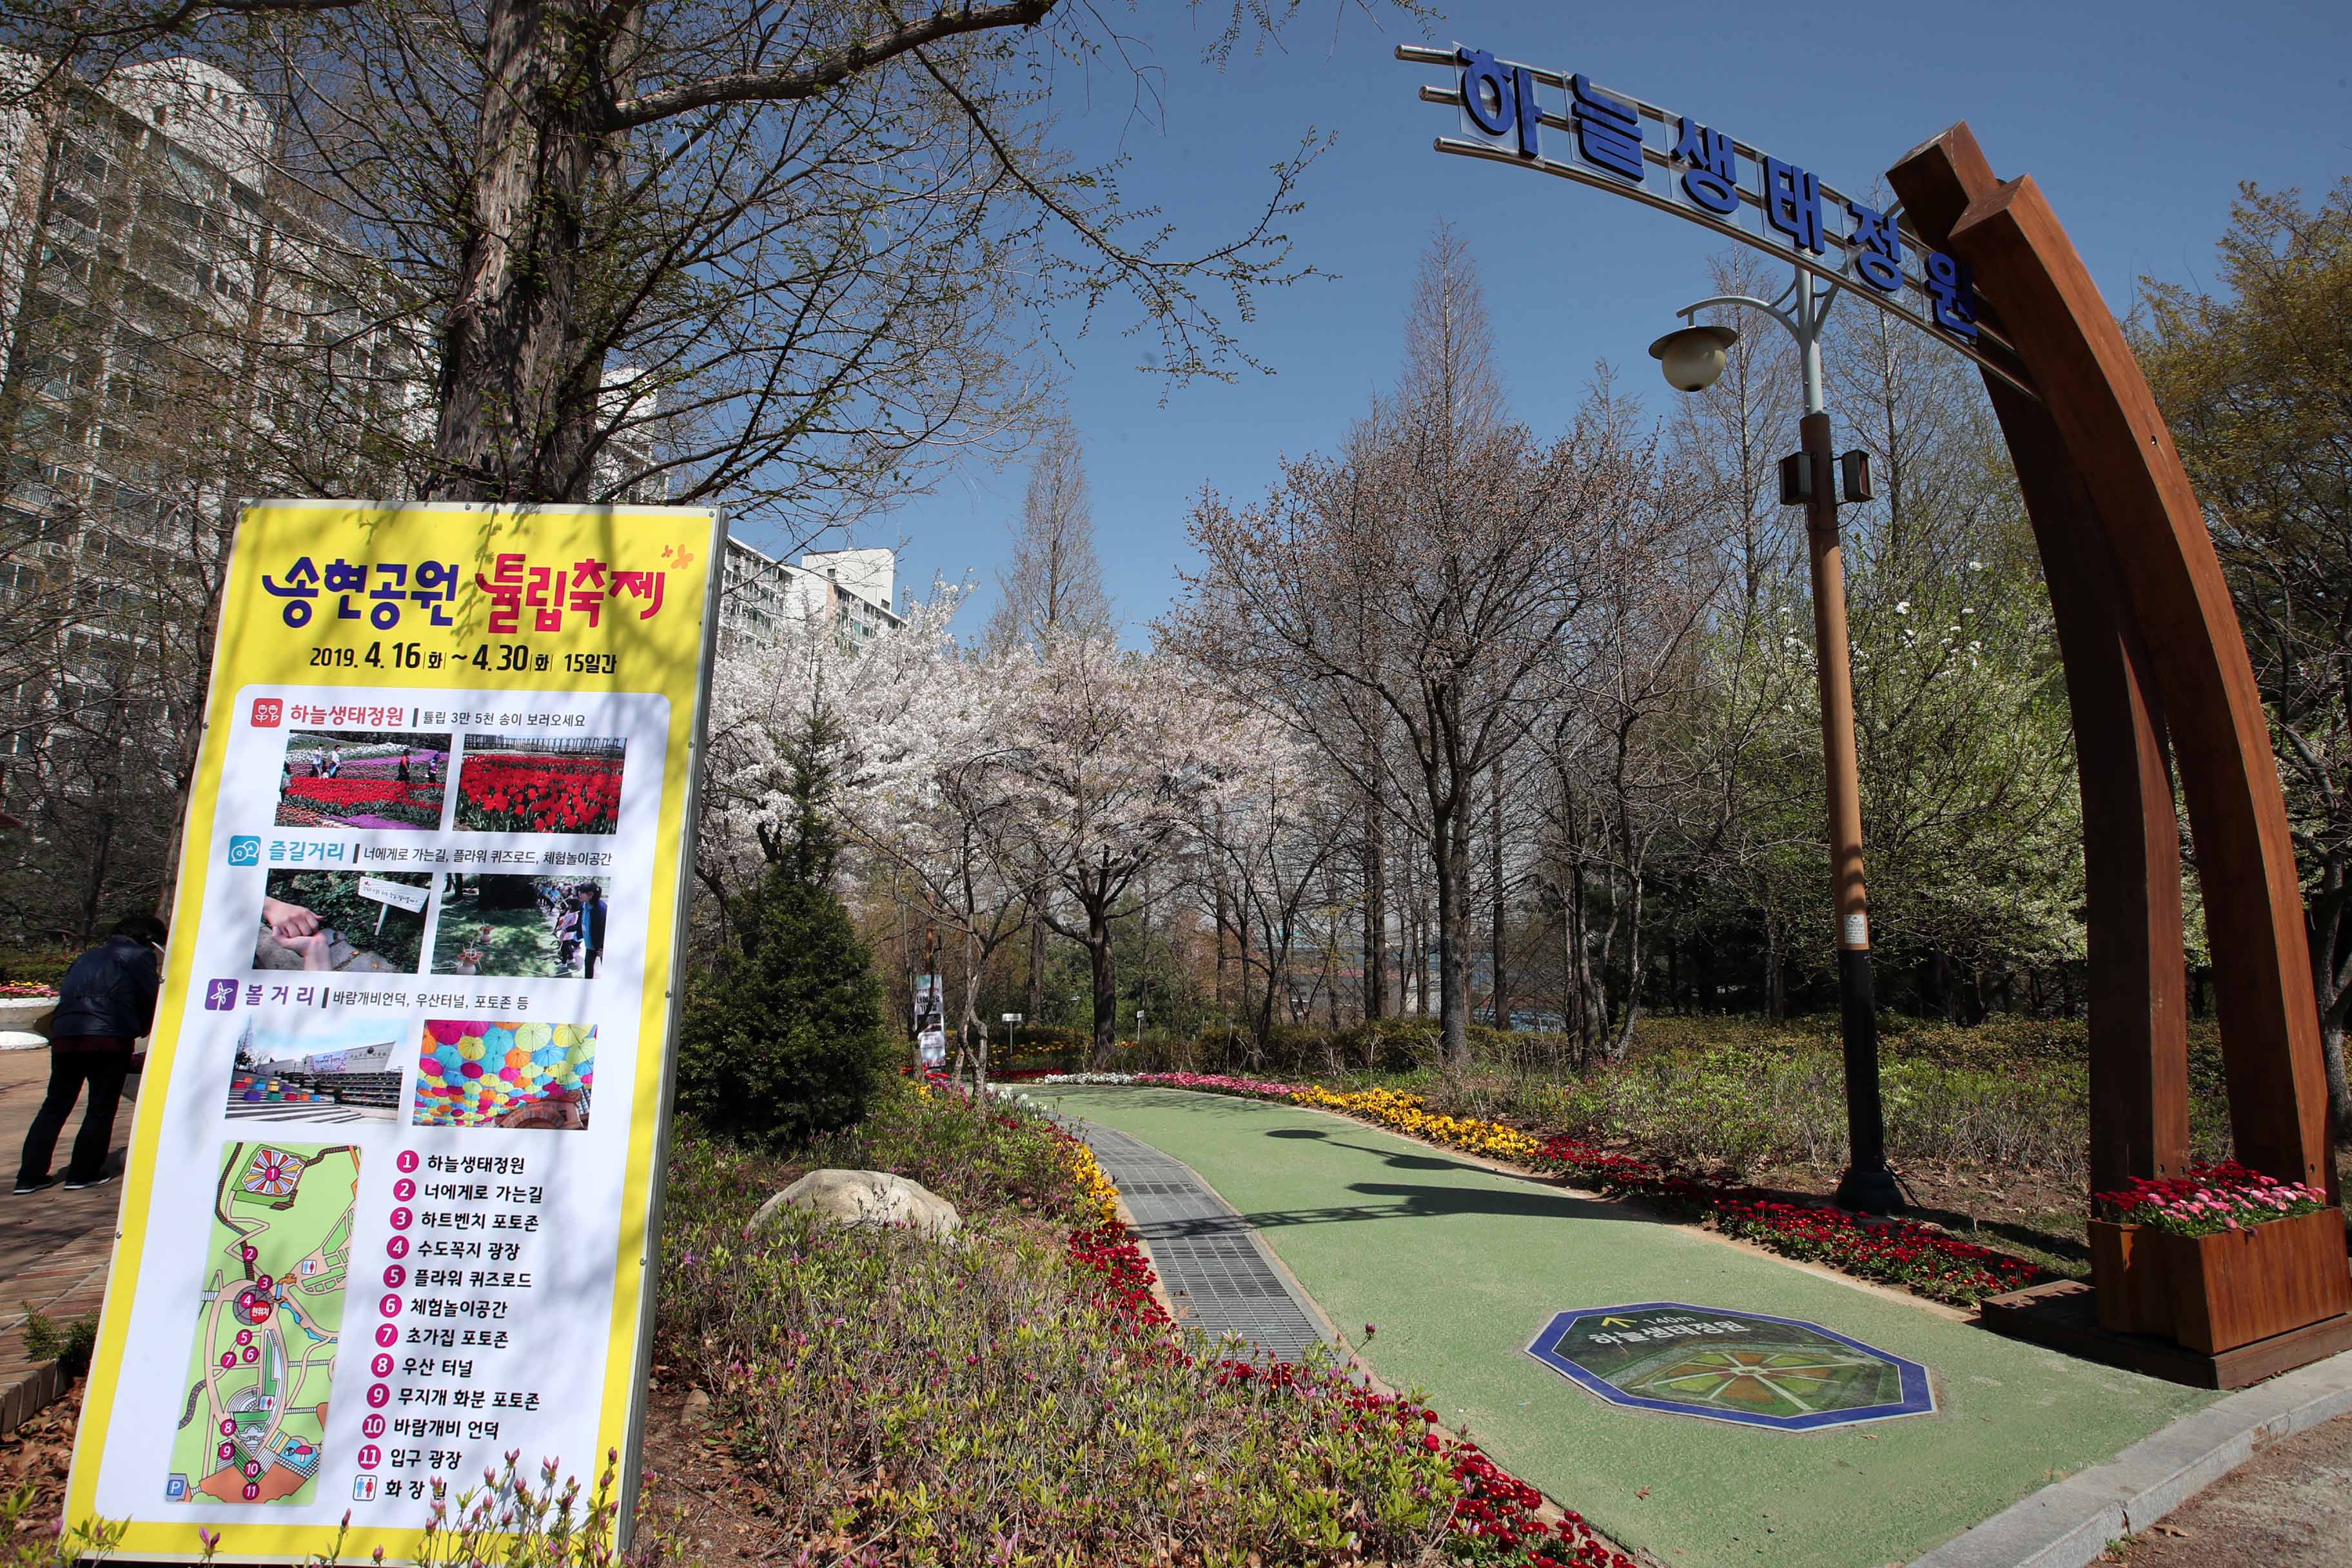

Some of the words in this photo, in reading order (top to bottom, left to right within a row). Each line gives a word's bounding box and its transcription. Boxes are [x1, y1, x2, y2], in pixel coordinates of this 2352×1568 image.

[1457, 48, 1979, 340] 하늘생태정원
[262, 556, 460, 631] 송현공원
[475, 553, 665, 634] 튤립축제
[310, 647, 358, 669] 2019.
[564, 653, 617, 674] 15일간
[290, 704, 404, 727] 하늘생태정원
[423, 711, 446, 725] 튤립
[451, 712, 471, 725] 3만
[475, 712, 495, 725] 5천
[499, 713, 522, 727] 송이
[526, 713, 585, 727] 보러오세요
[268, 840, 345, 862] 즐길거리
[364, 847, 409, 861] 너에게로
[412, 848, 449, 863] 가는길,
[453, 849, 487, 863] 플라워
[490, 850, 539, 865] 퀴즈로드,
[542, 851, 612, 866] 체험놀이공간
[333, 991, 409, 1008] 바람개비언덕,
[415, 993, 469, 1010] 우산터널,
[474, 995, 511, 1010] 포토존
[516, 996, 529, 1010] 등
[427, 1154, 525, 1175] 하늘생태정원
[424, 1184, 489, 1200] 너에게로
[496, 1186, 543, 1204] 가는길
[421, 1211, 486, 1230] 하트벤치
[491, 1214, 539, 1232] 포토존
[417, 1240, 481, 1259] 수도꼭지
[487, 1242, 521, 1261] 광장
[414, 1269, 463, 1287] 플라워
[469, 1271, 532, 1288] 퀴즈로드
[252, 1307, 270, 1317] 현위치
[410, 1298, 508, 1319] 체험놀이공간
[1643, 1315, 1696, 1325] 140m
[406, 1327, 455, 1348] 초가집
[460, 1330, 509, 1349] 포토존
[1588, 1320, 1751, 1344] 하늘생태정원
[402, 1357, 435, 1377] 우산
[442, 1359, 473, 1378] 터널
[398, 1387, 447, 1407] 무지개
[453, 1389, 485, 1409] 화분
[491, 1392, 540, 1411] 포토존
[393, 1418, 461, 1438] 바람개비
[467, 1421, 499, 1440] 언덕
[391, 1449, 422, 1468] 입구
[428, 1450, 462, 1471] 광장
[171, 1480, 181, 1494] P
